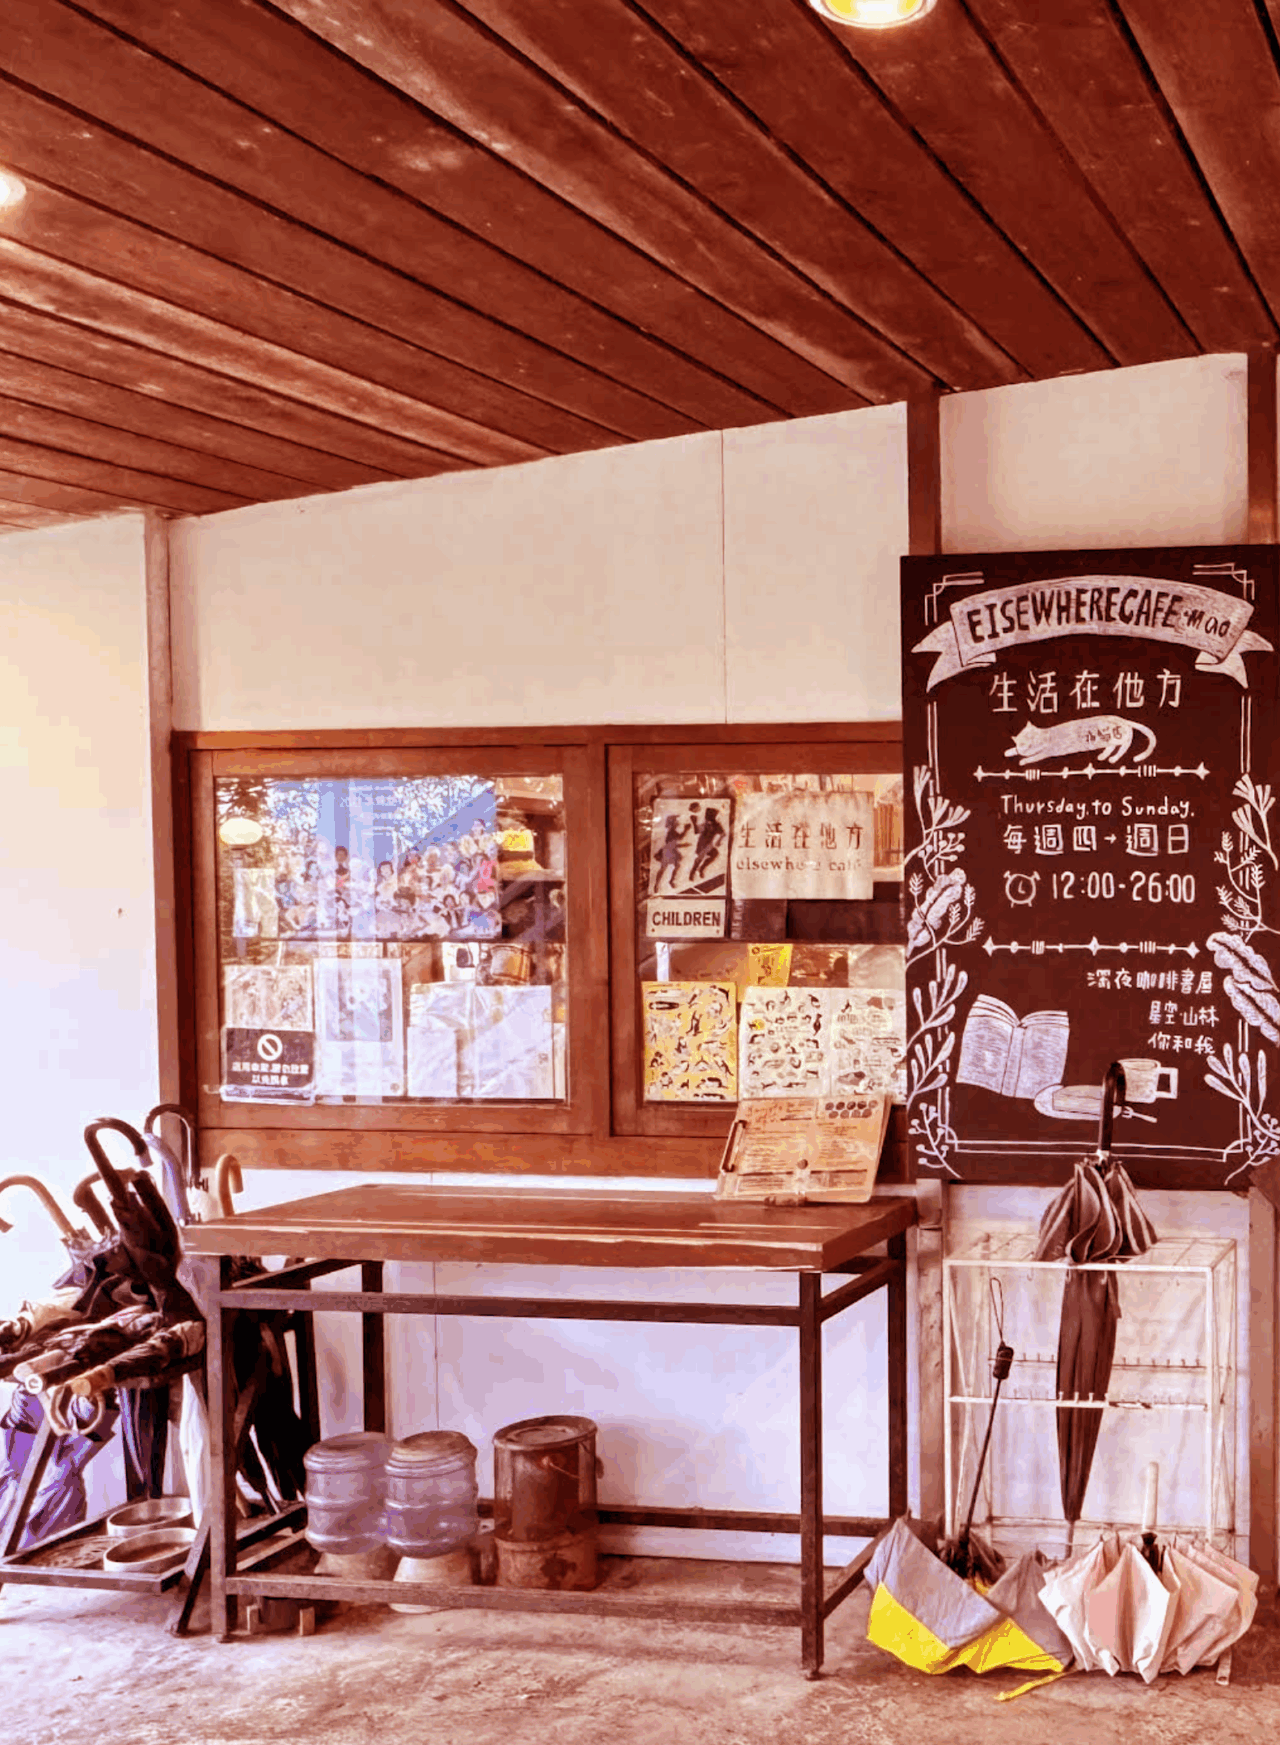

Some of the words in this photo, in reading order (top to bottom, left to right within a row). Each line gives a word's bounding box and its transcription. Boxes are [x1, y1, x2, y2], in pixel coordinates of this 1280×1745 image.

[988, 669, 1182, 713] 生活在他方
[1091, 799, 1112, 815] to
[738, 822, 864, 850] 生活在他方
[736, 856, 821, 870] elsewhee
[1052, 870, 1196, 904] 12:00-26:00
[652, 911, 721, 927] CHILDREN
[1086, 966, 1214, 994] 深夜咖啡書屋
[1147, 1031, 1216, 1055] 你和我
